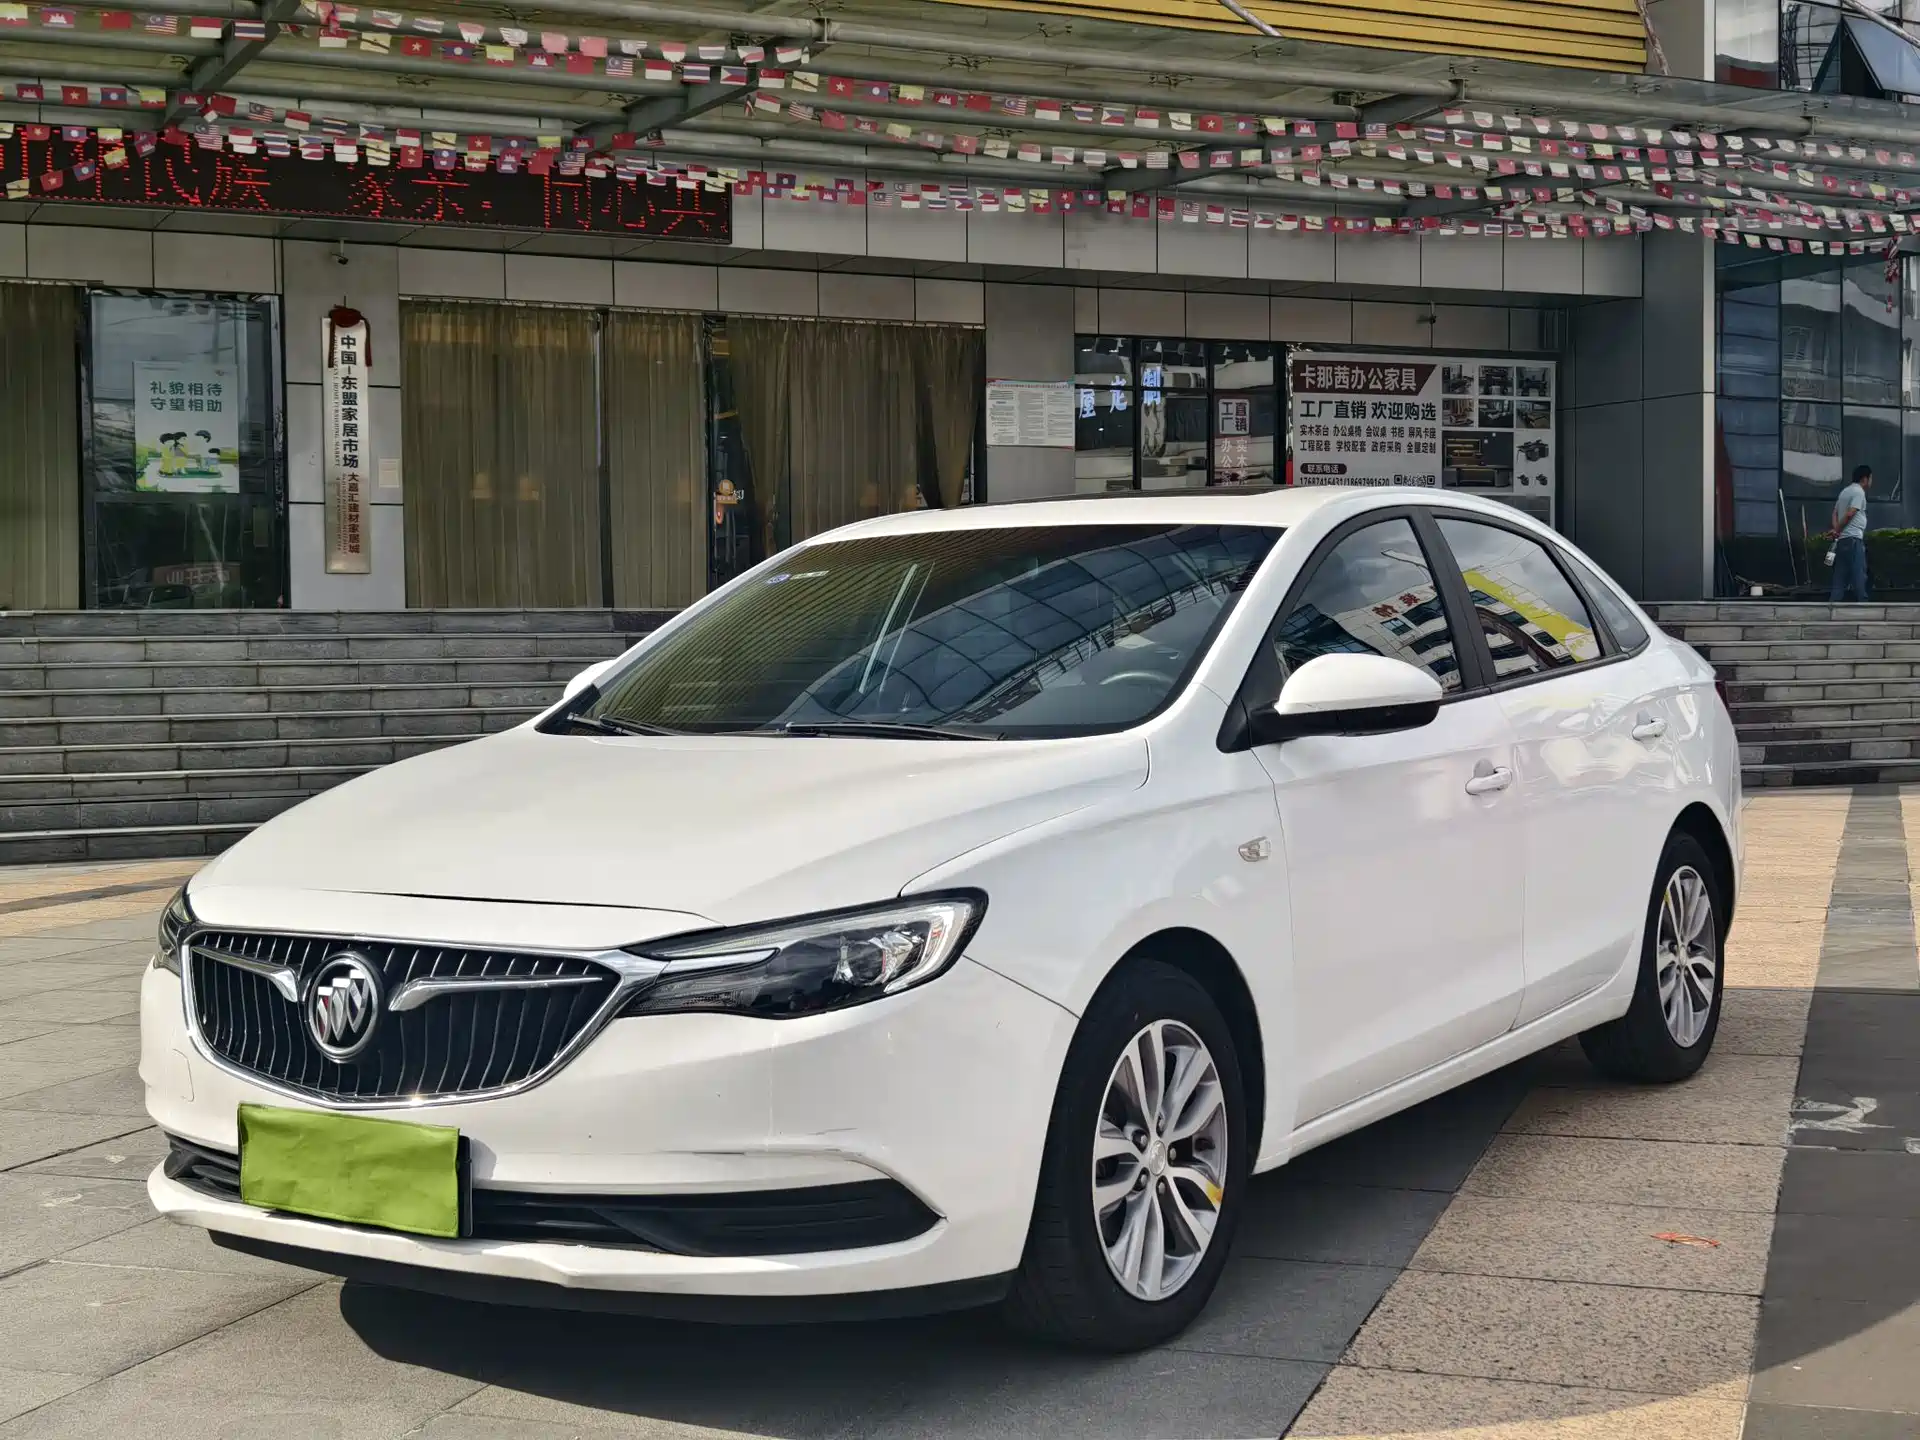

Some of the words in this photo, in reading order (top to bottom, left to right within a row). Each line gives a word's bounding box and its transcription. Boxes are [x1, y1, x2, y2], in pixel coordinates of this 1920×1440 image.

[1300, 364, 1417, 391] 卡那茜办公家具
[150, 381, 223, 396] 礼貌相待
[150, 397, 223, 412] 守望相助
[1300, 400, 1367, 419] 工厂直销
[1371, 402, 1437, 421] 欢迎购选
[1300, 424, 1330, 437] 实木茶台
[1333, 425, 1362, 437] 办公桌椅
[1365, 426, 1387, 438] 会议桌
[1300, 440, 1331, 452] 工程配套
[1336, 441, 1367, 453] 学校配套
[1371, 441, 1402, 453] 政府采购
[1307, 464, 1340, 474] 联系电话
